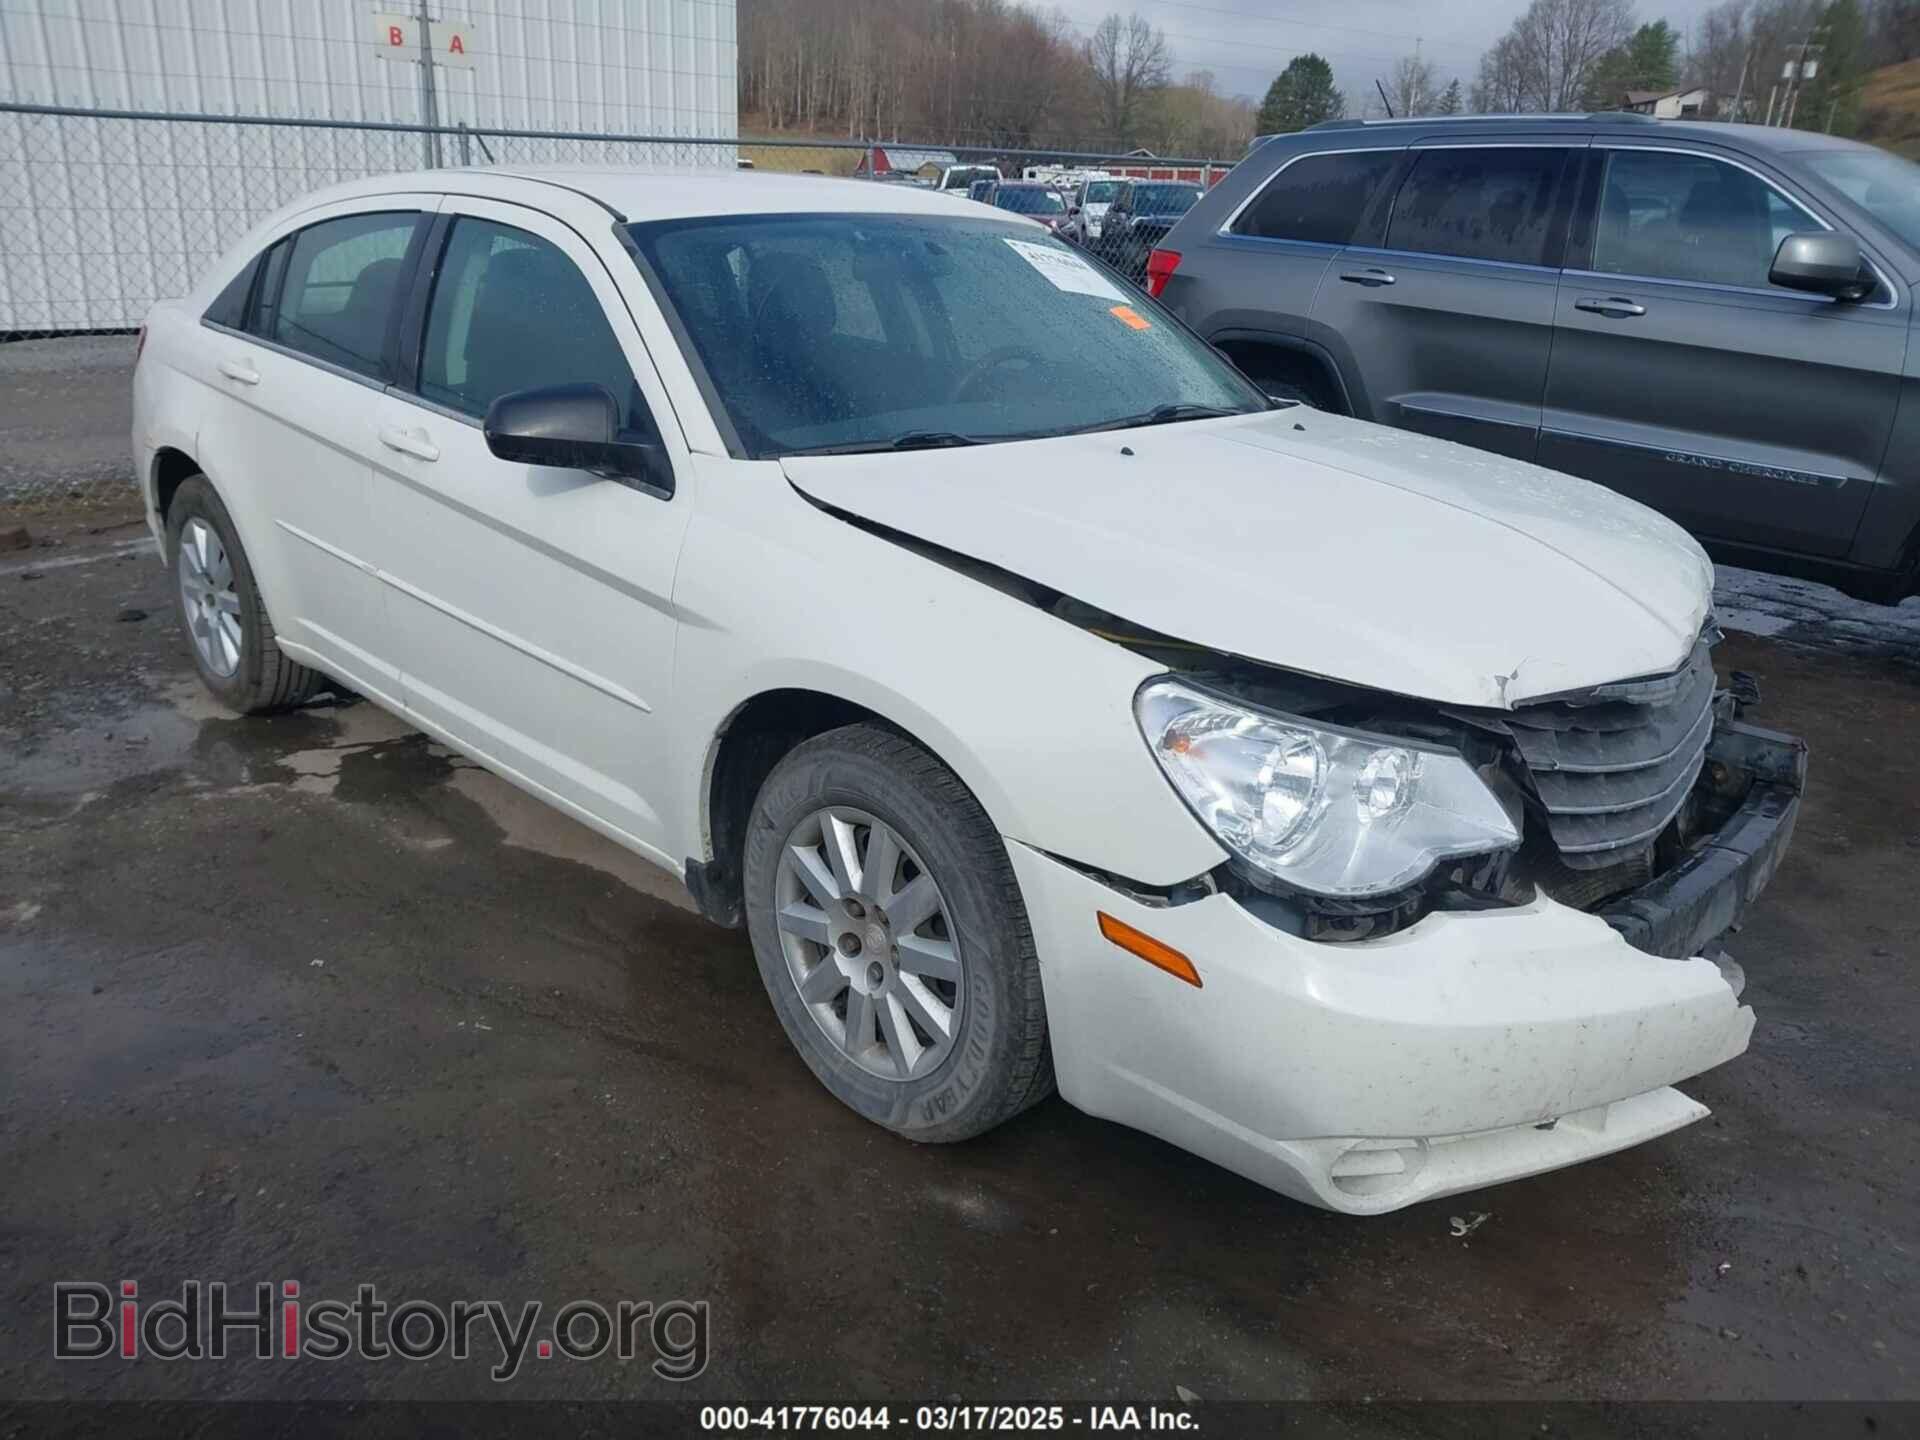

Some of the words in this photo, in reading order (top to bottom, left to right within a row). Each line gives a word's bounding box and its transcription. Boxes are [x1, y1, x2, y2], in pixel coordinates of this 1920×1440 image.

[389, 26, 403, 46] B
[449, 35, 464, 54] A
[1665, 453, 1722, 469] GRAND
[1728, 463, 1819, 486] CHEROKEE
[921, 973, 991, 1122] GOODYEAR
